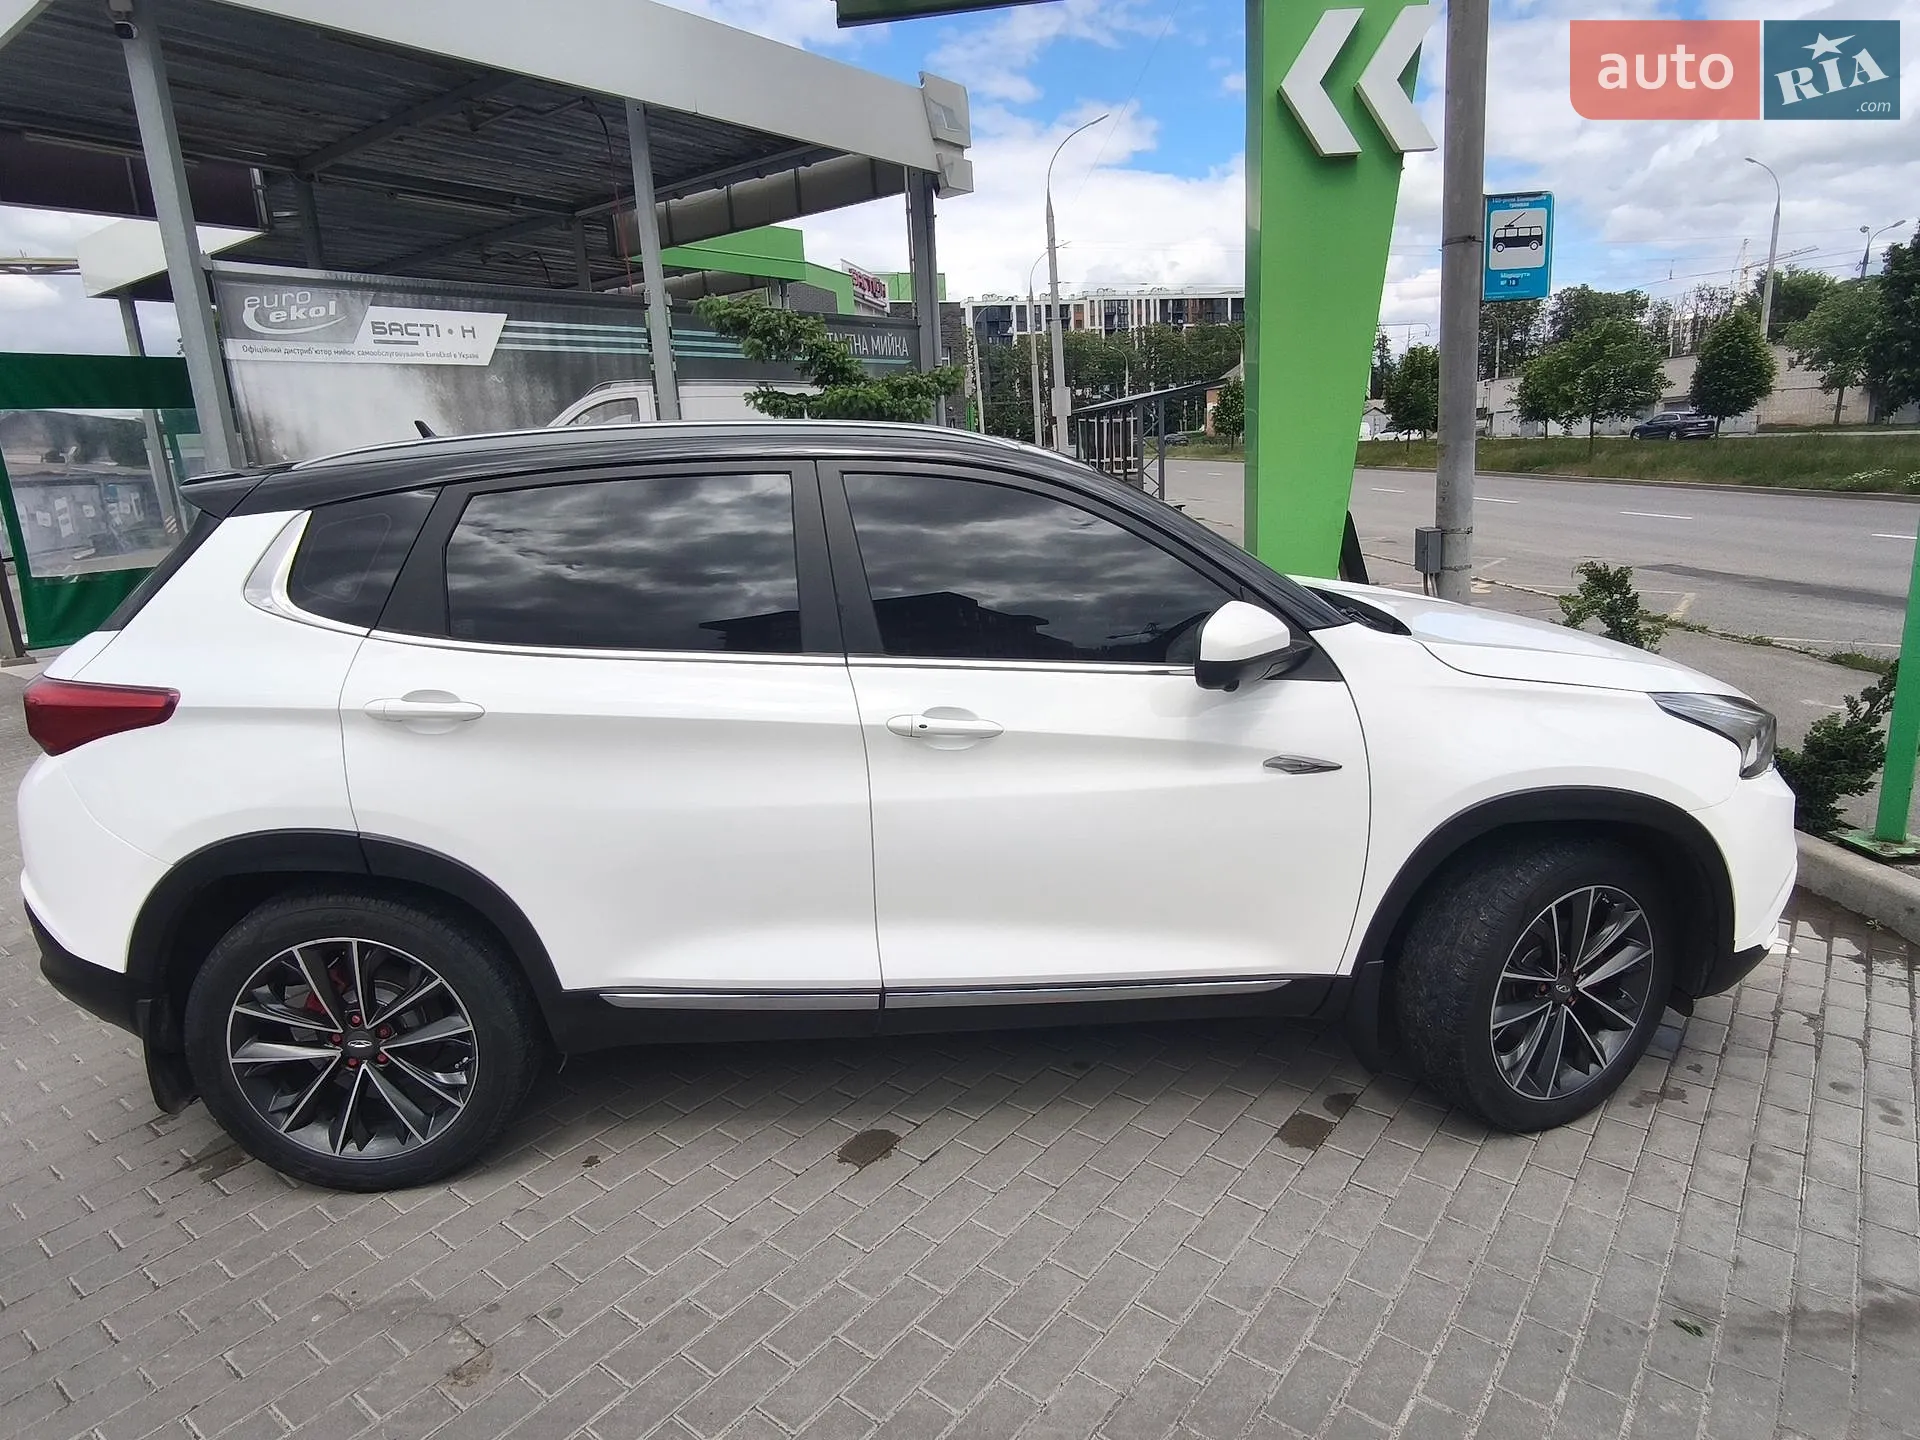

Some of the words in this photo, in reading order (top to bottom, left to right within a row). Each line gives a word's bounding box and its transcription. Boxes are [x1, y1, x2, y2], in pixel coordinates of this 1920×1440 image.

[244, 291, 311, 308] euro
[269, 300, 336, 322] ekol
[241, 344, 281, 354] Офіційний
[870, 332, 909, 356] МИЙКА
